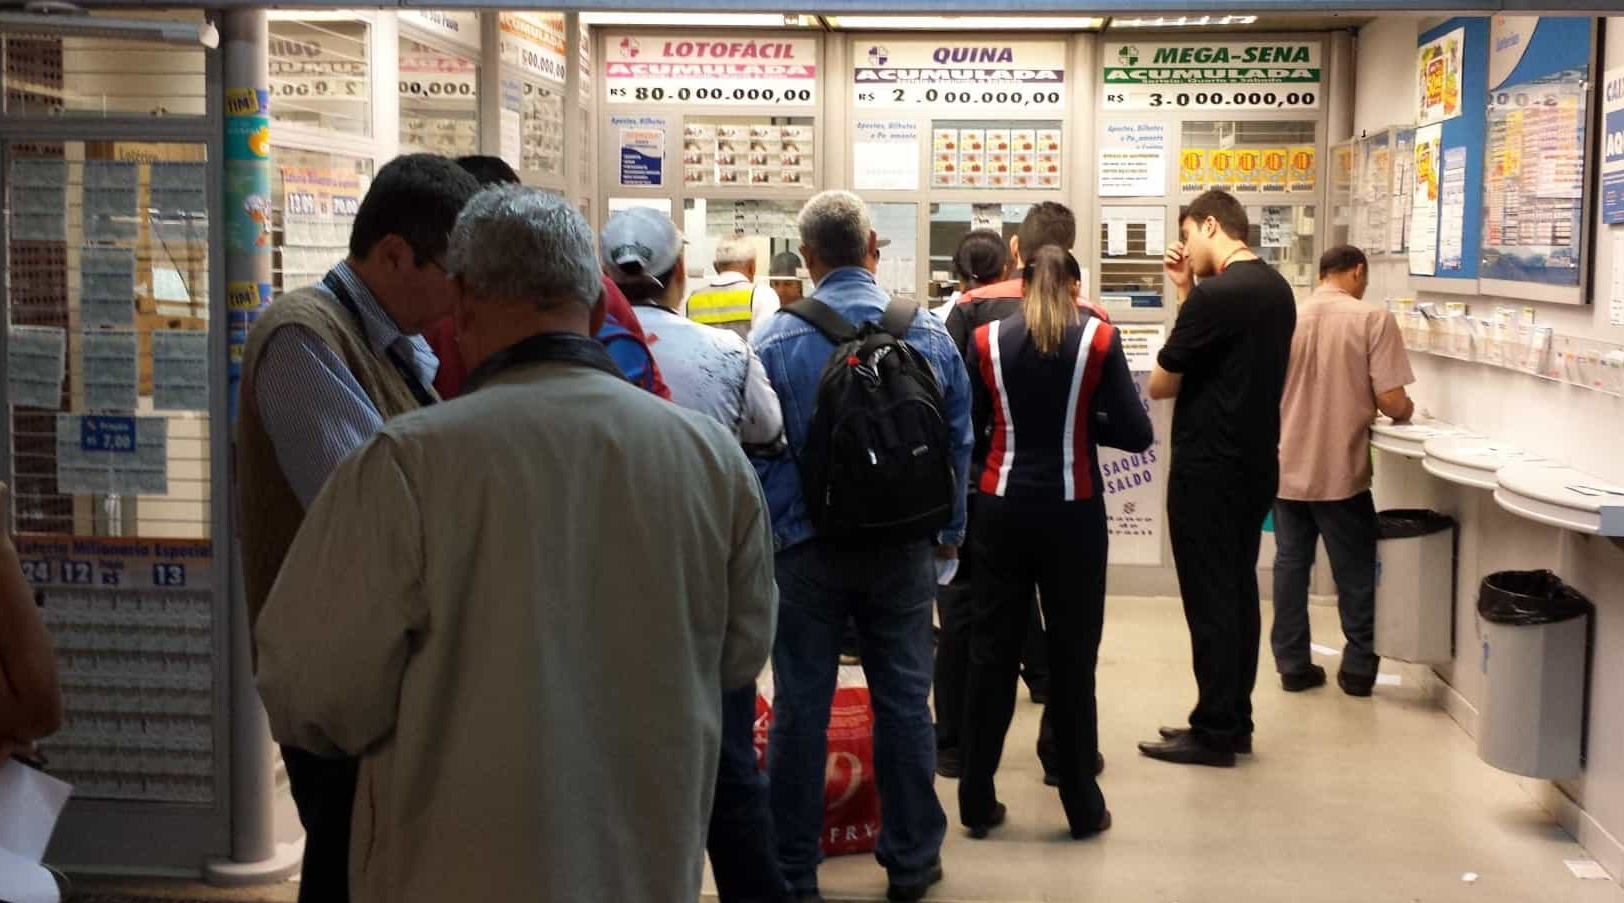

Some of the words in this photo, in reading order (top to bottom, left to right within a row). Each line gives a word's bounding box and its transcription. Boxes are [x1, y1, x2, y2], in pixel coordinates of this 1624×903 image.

[663, 39, 795, 59] LOTOFÁCIL
[933, 47, 1013, 64] QUINA
[1153, 46, 1310, 64] MEGA-SENA
[608, 64, 807, 76] ACUMULADA
[856, 69, 1058, 80] ACUMULADA
[1107, 69, 1313, 80] ACUMULADA
[1107, 94, 1124, 103] R$
[103, 435, 131, 449] 7,00
[1103, 449, 1156, 477] SAQUES
[1107, 469, 1153, 494] SALDO
[63, 562, 91, 583] 12
[156, 565, 184, 585] 13
